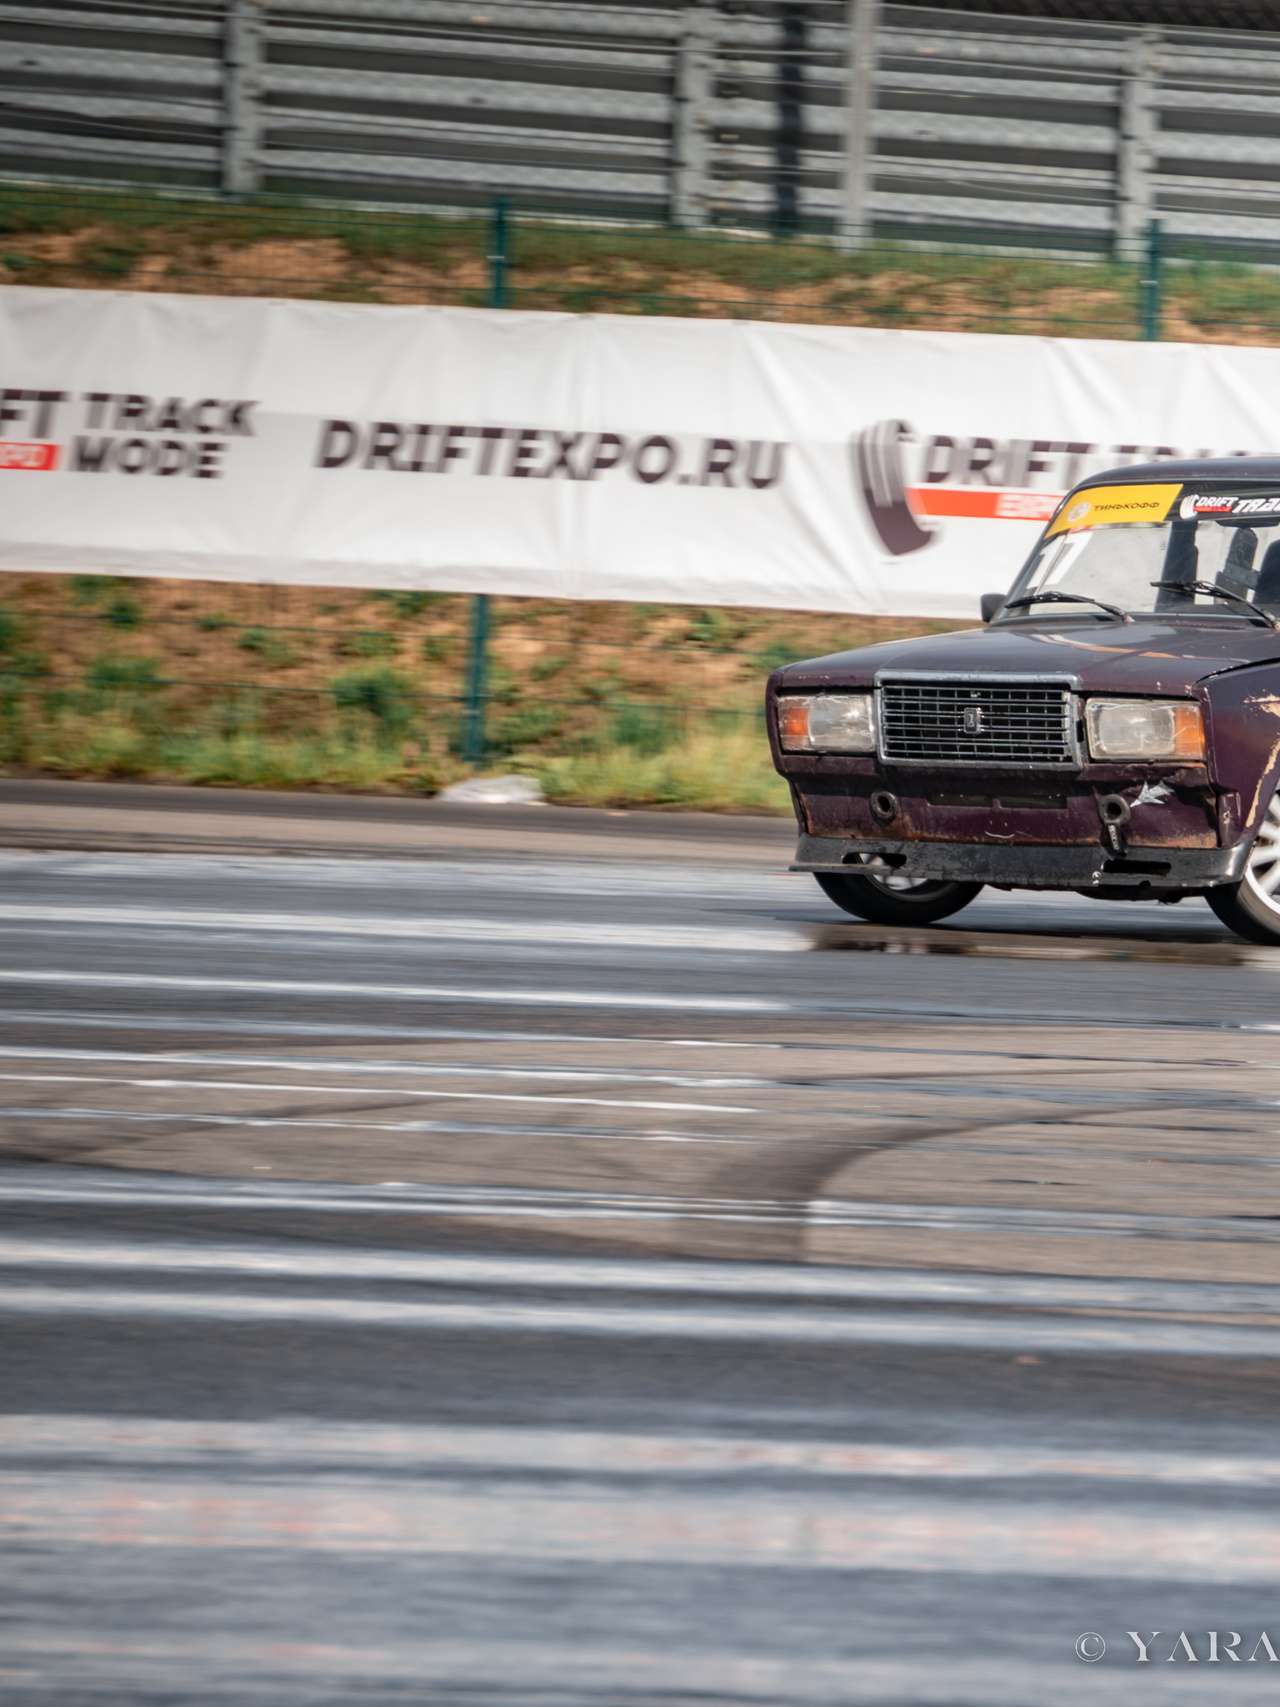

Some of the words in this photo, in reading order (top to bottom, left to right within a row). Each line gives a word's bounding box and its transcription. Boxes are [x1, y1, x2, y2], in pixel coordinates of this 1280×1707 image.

[83, 392, 260, 437] TRACK
[70, 435, 230, 479] MODE
[313, 419, 788, 489] DRIFTEXPO.RU
[922, 435, 1092, 490] DRIFT
[1094, 502, 1160, 511] ТИНЬКОФФ
[1197, 496, 1239, 507] DRIFT
